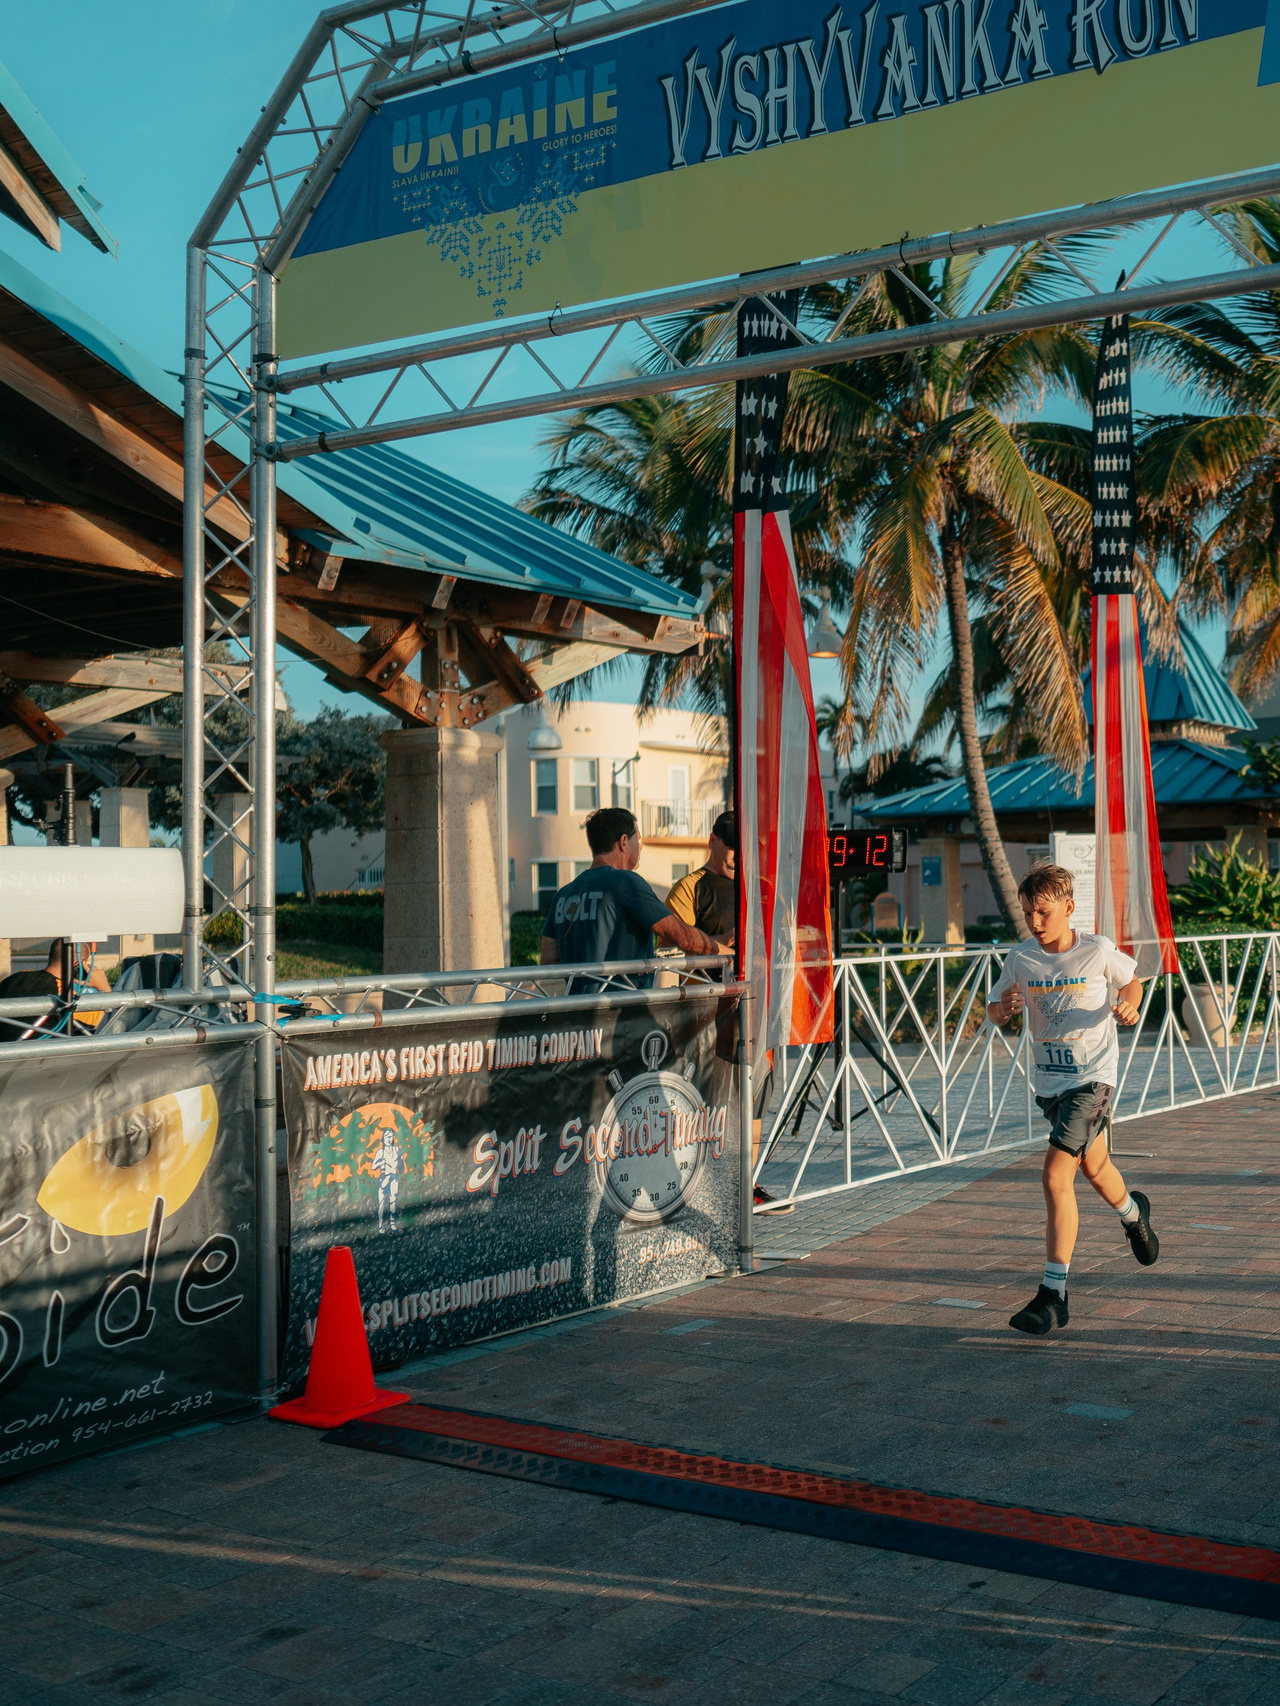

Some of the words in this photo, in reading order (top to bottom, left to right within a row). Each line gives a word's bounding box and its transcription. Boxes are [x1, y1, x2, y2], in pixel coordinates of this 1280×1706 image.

[658, 0, 1055, 171] VYSHYVANKA
[391, 60, 618, 174] UKRAINE
[542, 136, 568, 151] GLORY
[571, 133, 582, 145] TO
[584, 125, 617, 139] HEROES!
[392, 174, 418, 189] SLAVA
[420, 166, 459, 181] UKRAINI!
[555, 891, 603, 924] BOLT
[1028, 976, 1086, 994] UKRAINE
[303, 1048, 397, 1091] AMERICA'S
[400, 1043, 446, 1081] FIRST
[448, 1040, 484, 1075] RFID
[486, 1035, 538, 1070] TIMING
[540, 1028, 603, 1065] COMPANY
[1045, 1048, 1074, 1065] 116
[648, 1095, 659, 1104] 60
[631, 1106, 642, 1115] 55
[466, 1124, 548, 1198] Split
[553, 1105, 652, 1177] Second
[659, 1102, 728, 1160] Timing
[680, 1161, 688, 1170] 20
[619, 1173, 629, 1182] 40
[666, 1180, 677, 1191] 25
[632, 1188, 642, 1198] 35
[649, 1193, 660, 1201] 30
[0, 1370, 166, 1436] online.net
[72, 1391, 213, 1443] 954-661-2732
